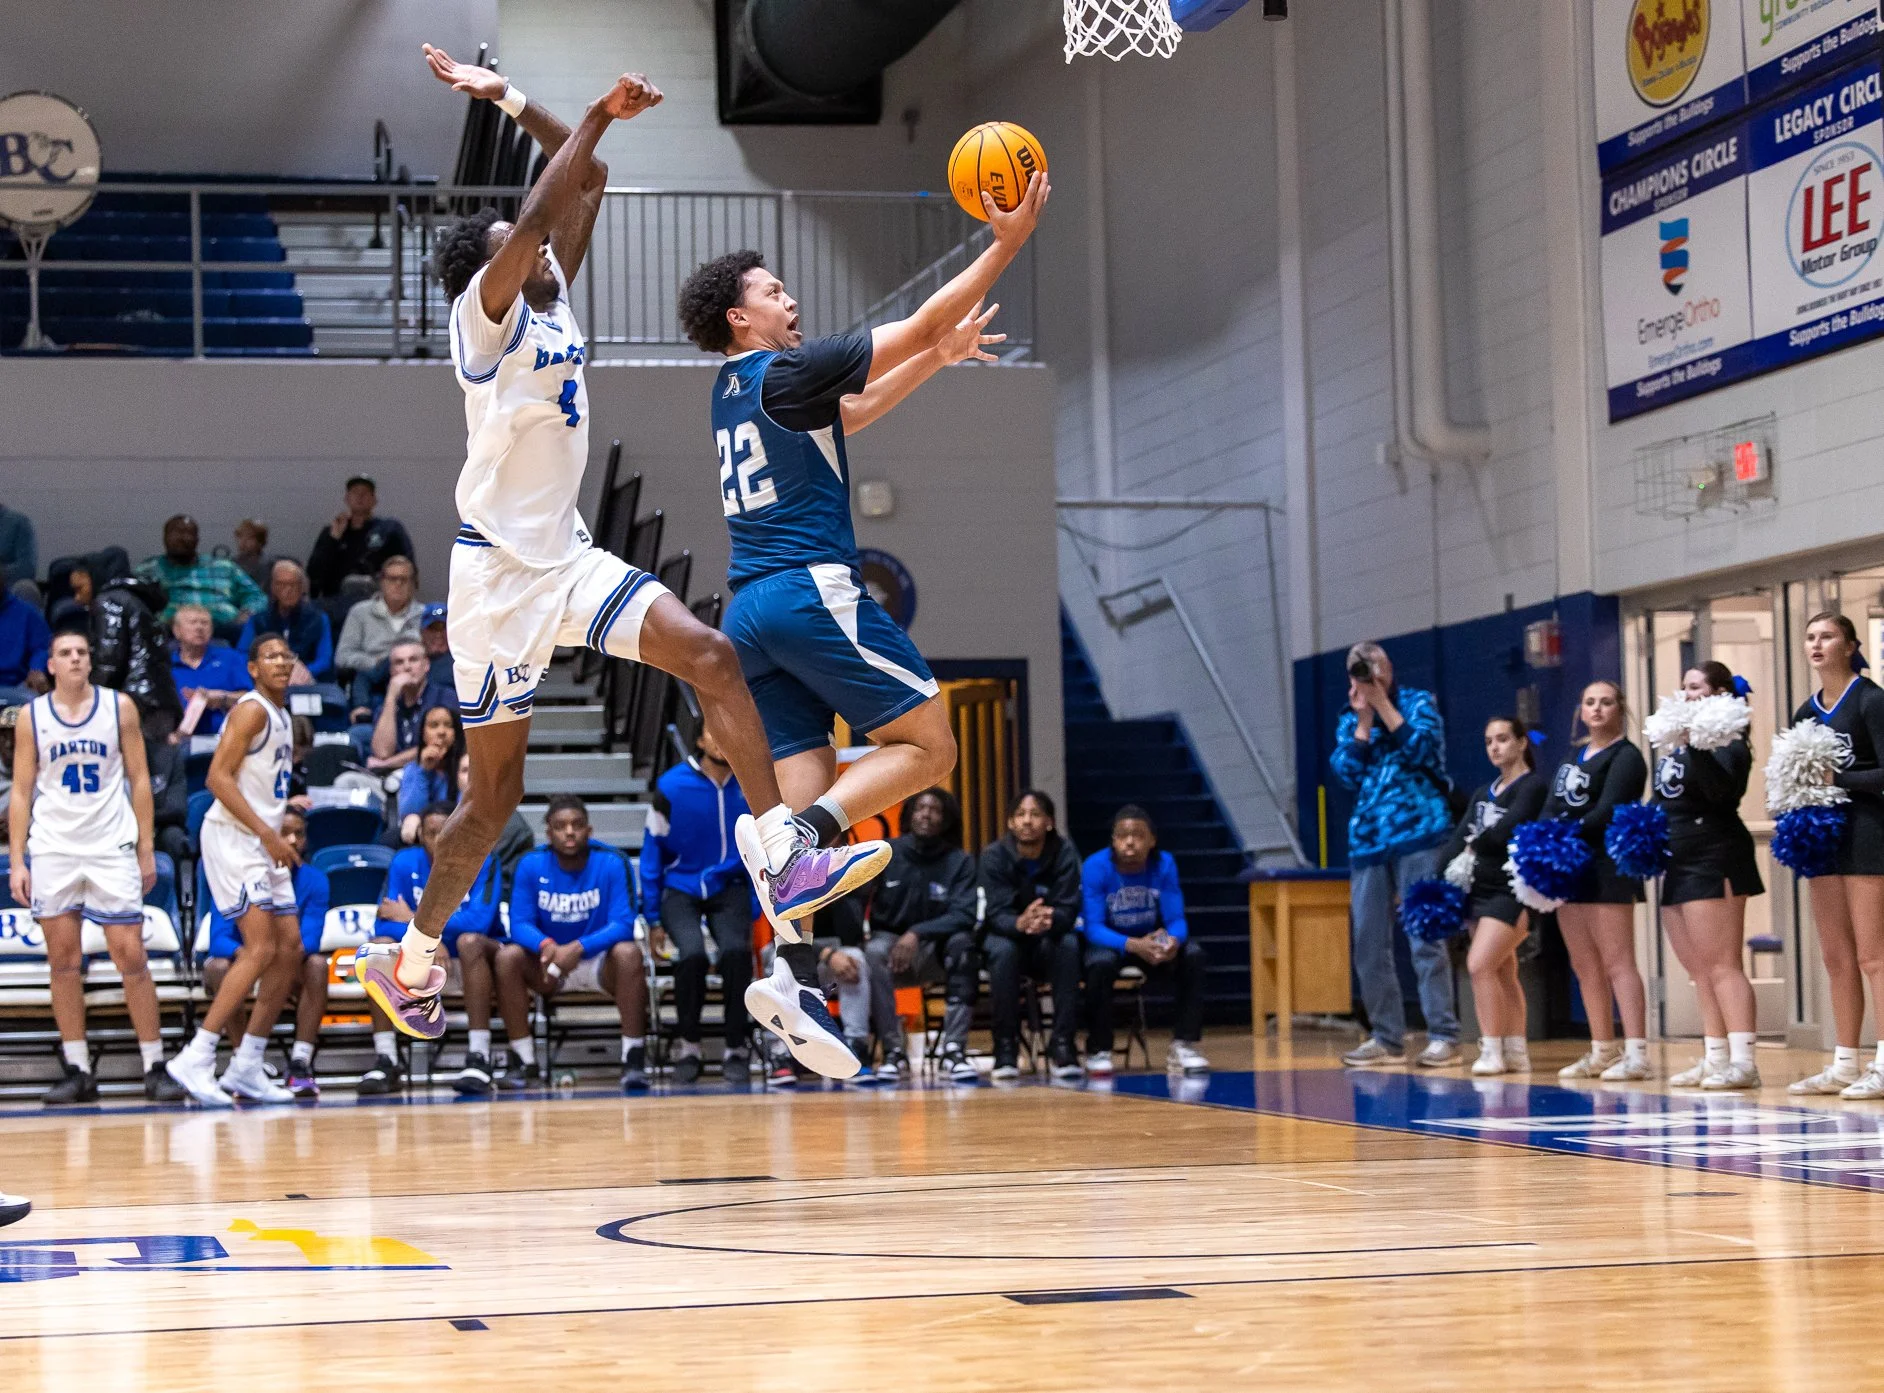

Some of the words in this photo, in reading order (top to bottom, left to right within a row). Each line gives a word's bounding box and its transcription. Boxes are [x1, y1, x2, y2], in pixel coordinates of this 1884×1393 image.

[1781, 43, 1821, 74] Supports
[1822, 35, 1838, 54] the
[1628, 120, 1663, 147] Supports
[1663, 113, 1678, 130] the
[1679, 96, 1714, 123] Bulldogs
[1775, 93, 1834, 143] LEGACY
[1840, 72, 1883, 114] CIRCL
[1813, 116, 1854, 144] SPONSOR
[1609, 159, 1689, 216] CHAMPIONS
[1692, 137, 1738, 179] CIRCLE
[1802, 161, 1872, 254] LEE
[1801, 252, 1836, 276] Motor
[1840, 238, 1878, 262] Group
[1638, 297, 1720, 345] EmergeOrtho
[1789, 320, 1831, 347] Supports
[1831, 314, 1848, 332] the
[1636, 374, 1671, 398] Supports
[1671, 368, 1685, 385] the
[1686, 357, 1722, 381] Bulldogs
[716, 420, 779, 517] 22
[50, 740, 107, 762] BARTON
[62, 764, 99, 793] 45
[538, 888, 600, 913] BARTON
